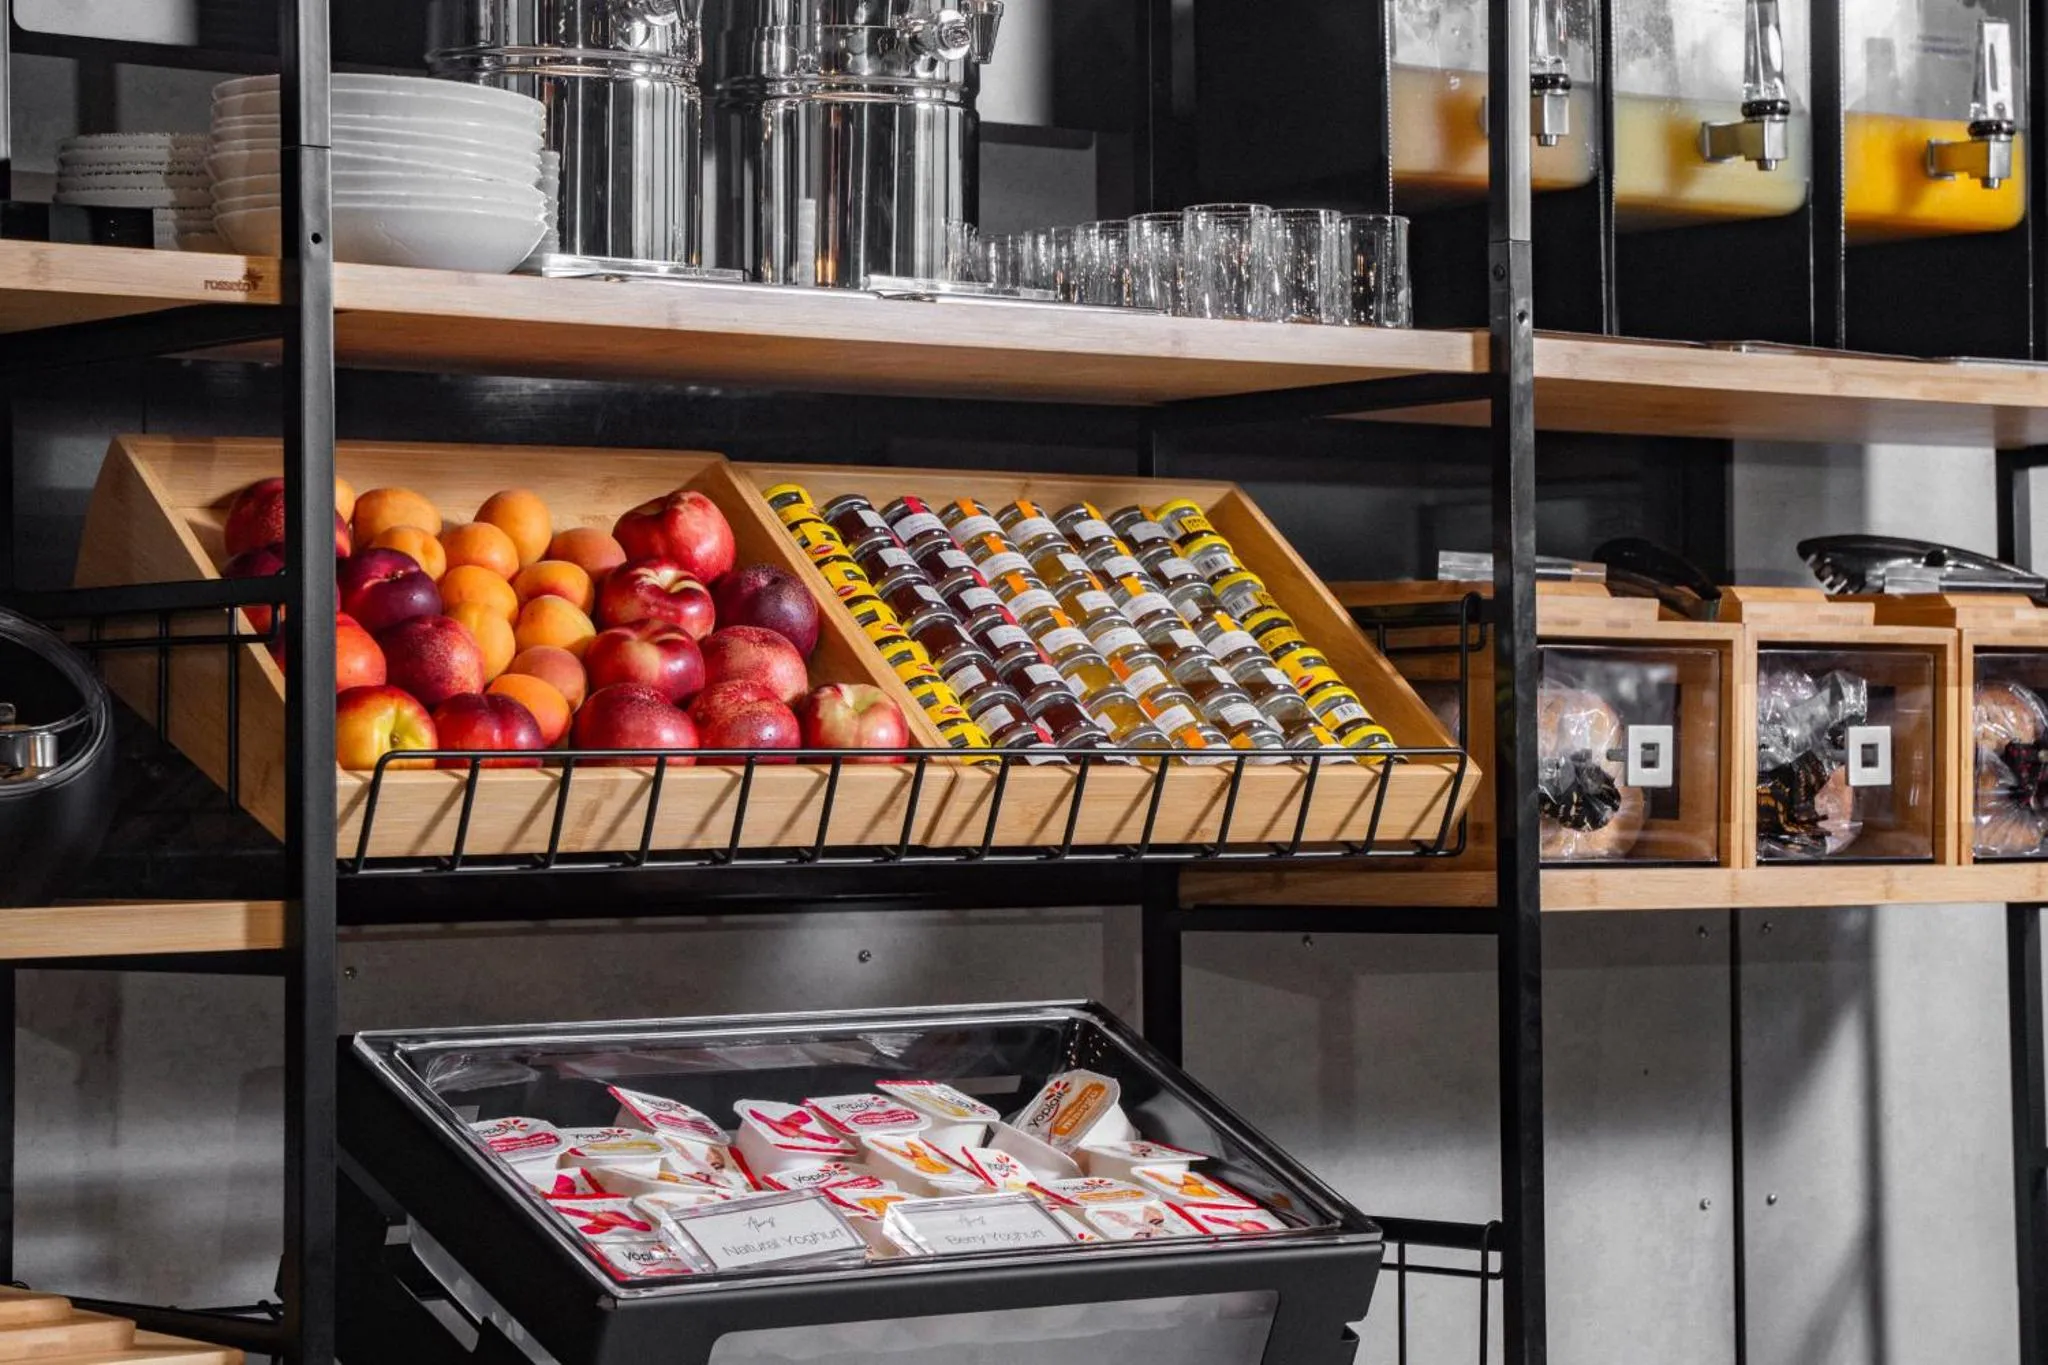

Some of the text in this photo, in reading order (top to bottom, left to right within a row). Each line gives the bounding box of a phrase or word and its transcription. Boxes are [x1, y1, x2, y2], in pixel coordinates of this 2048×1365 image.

[1028, 1091, 1066, 1128] Yoplait
[721, 1227, 845, 1257] Natural Yoghurt
[944, 1232, 986, 1245] Berry
